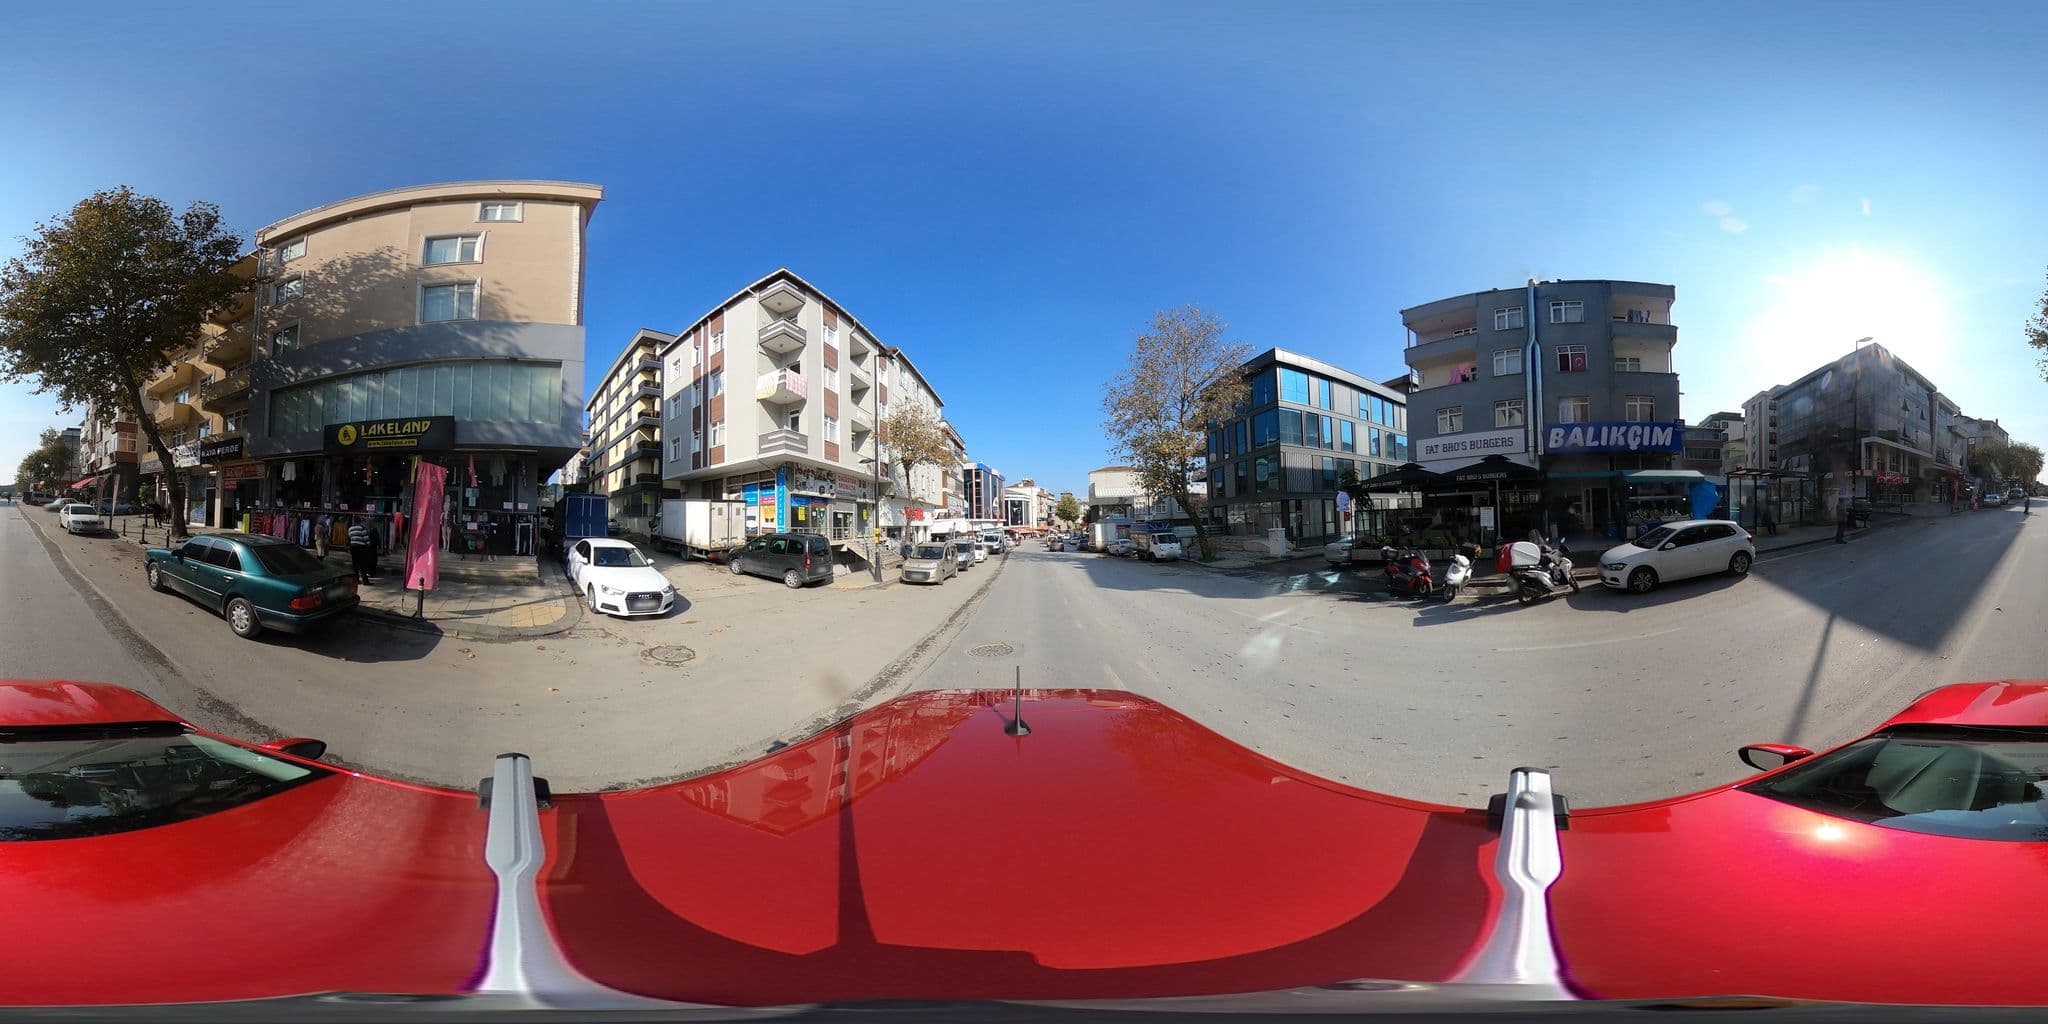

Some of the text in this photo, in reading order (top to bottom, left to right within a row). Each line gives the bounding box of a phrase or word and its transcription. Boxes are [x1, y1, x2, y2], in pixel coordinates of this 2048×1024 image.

[361, 420, 432, 436] LAKELAND
[1425, 436, 1514, 455] FAT BRO'S BURGERS
[1549, 425, 1674, 451] BALIKÇIM
[217, 444, 240, 456] PERDE
